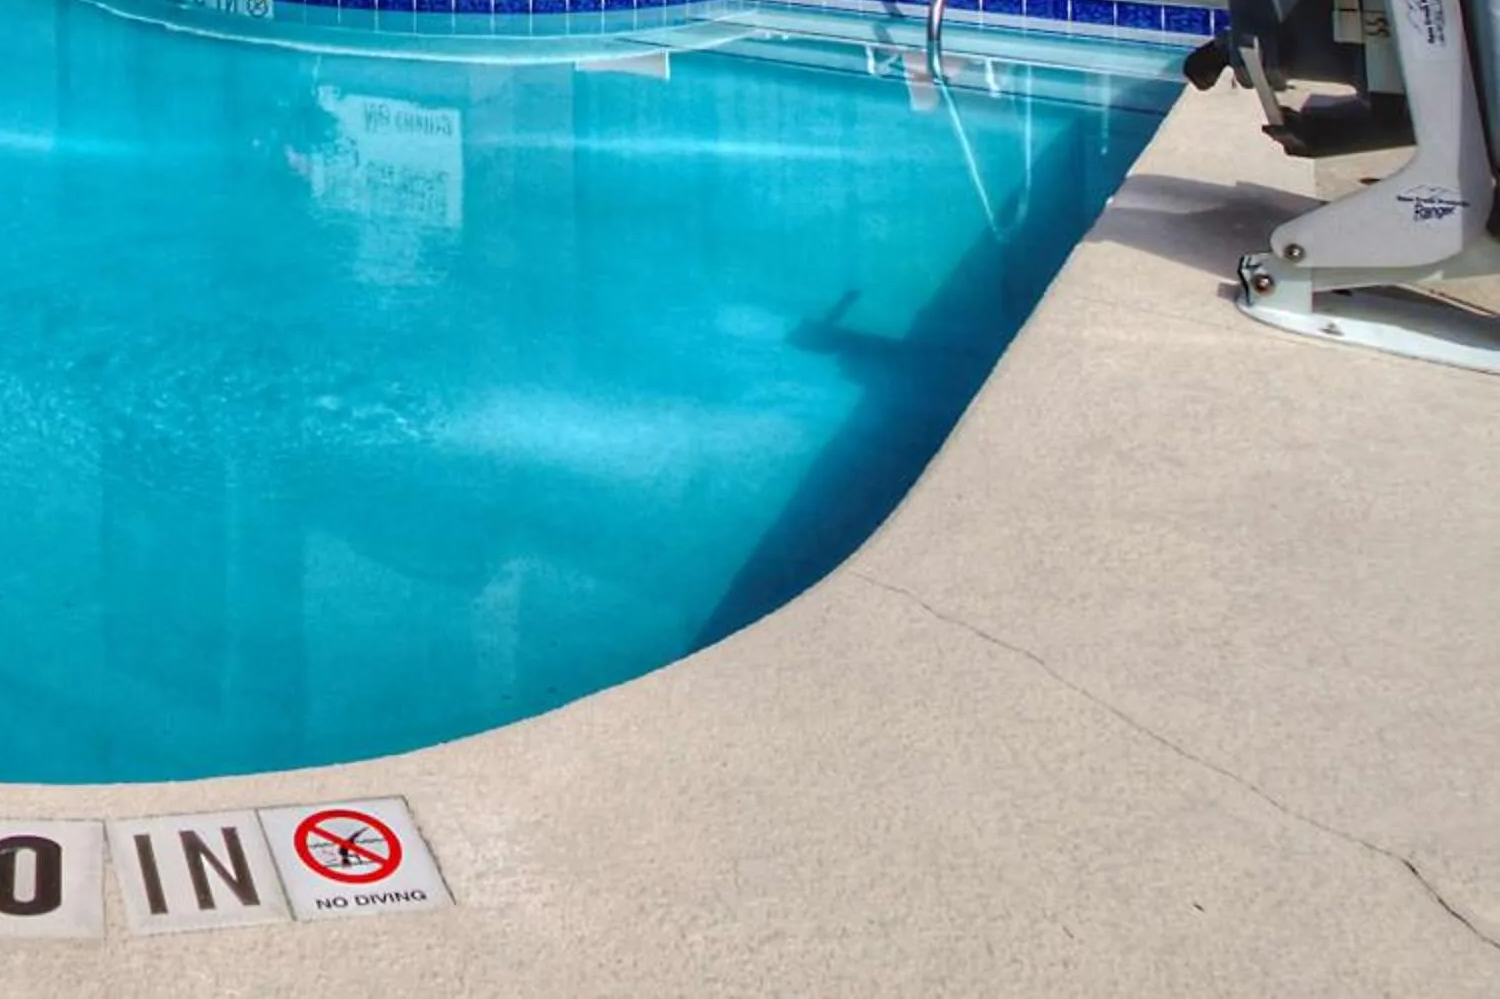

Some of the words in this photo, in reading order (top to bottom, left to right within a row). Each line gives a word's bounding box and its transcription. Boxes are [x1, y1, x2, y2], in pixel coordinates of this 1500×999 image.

[1413, 204, 1456, 221] Ranger
[133, 826, 261, 915] IN
[315, 896, 349, 909] NO
[354, 889, 428, 906] DIVING
